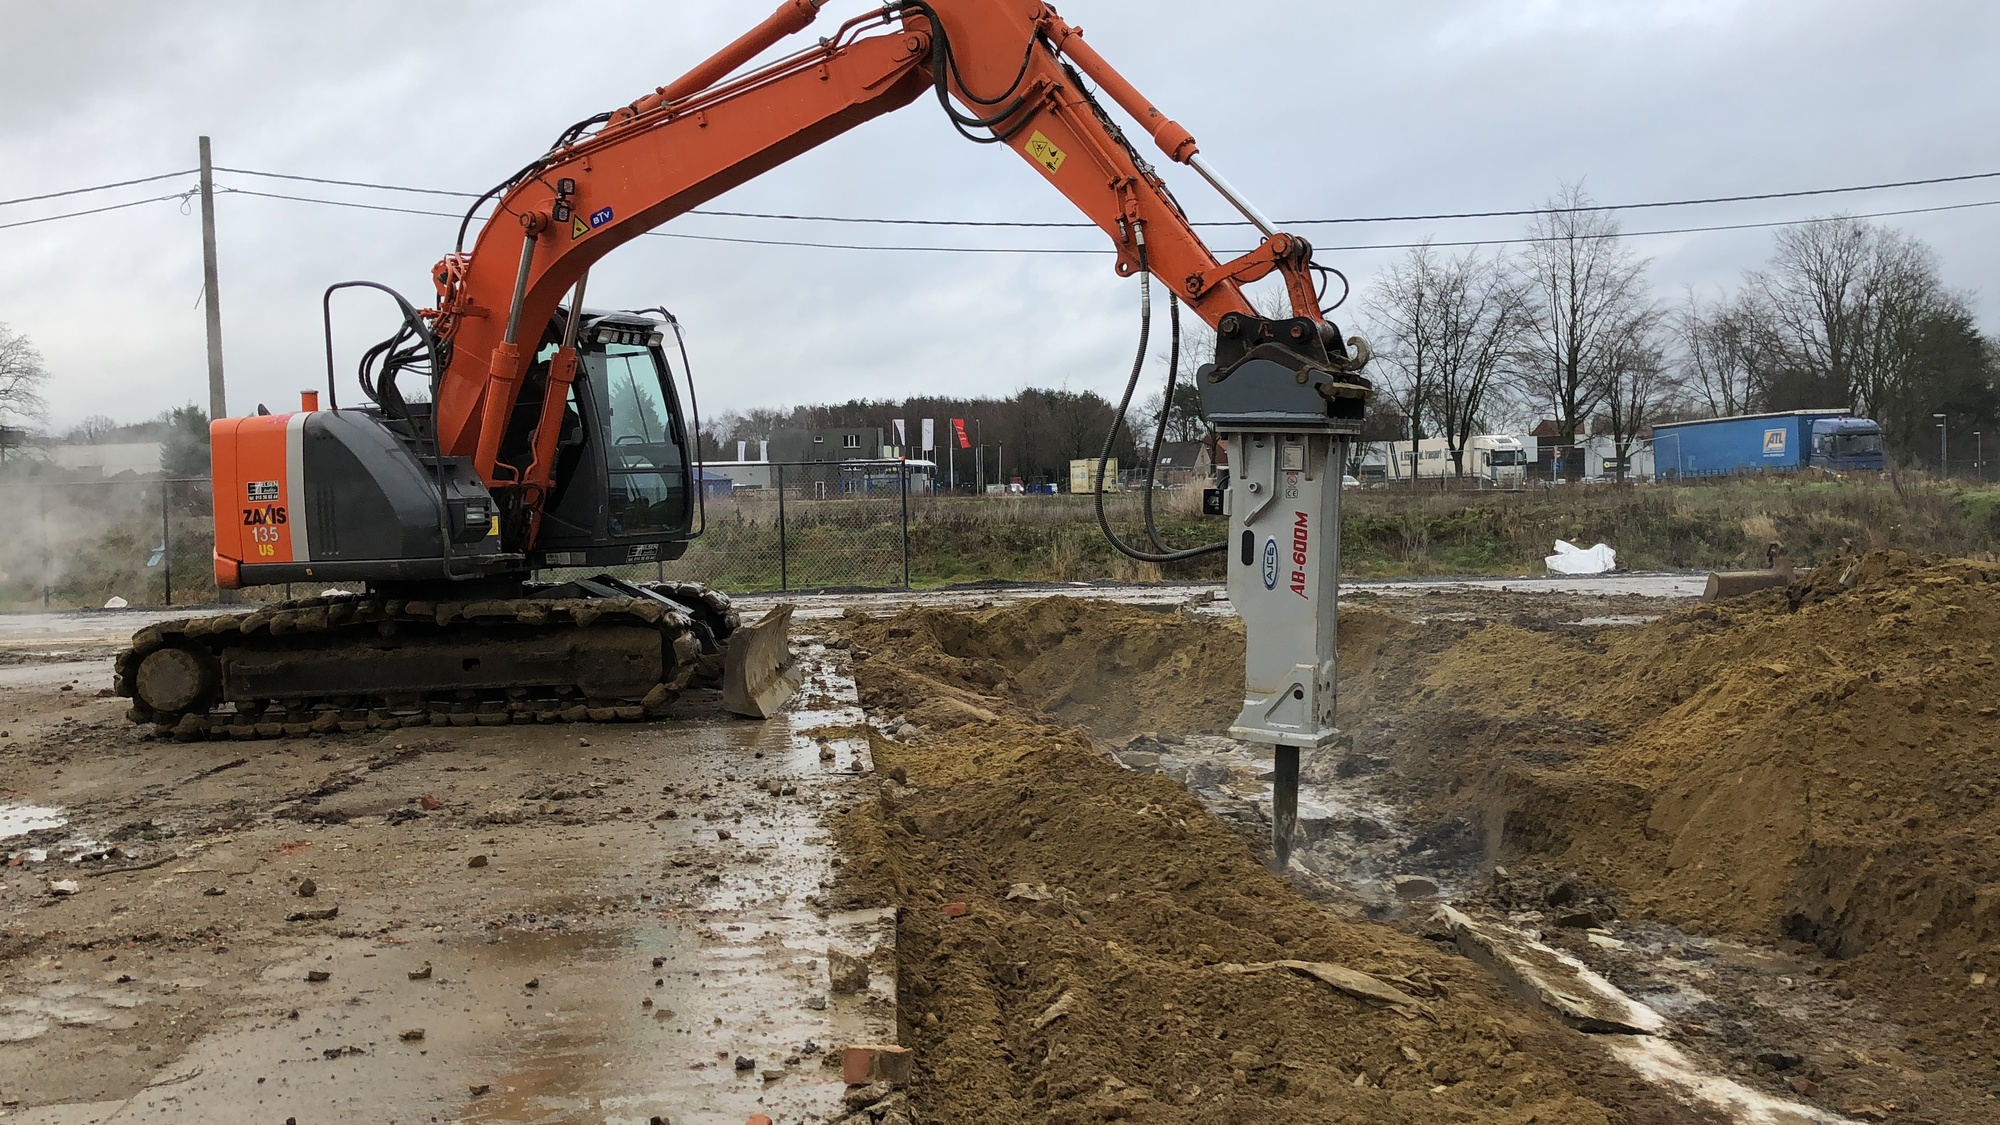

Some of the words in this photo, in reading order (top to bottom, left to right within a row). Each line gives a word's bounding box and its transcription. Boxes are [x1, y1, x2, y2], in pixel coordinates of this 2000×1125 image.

[1766, 432, 1783, 447] ATL
[243, 504, 287, 525] ZAXIS
[252, 526, 279, 543] 135
[259, 544, 275, 556] US
[1290, 511, 1309, 600] AB-600M
[1266, 547, 1275, 581] AJCE
